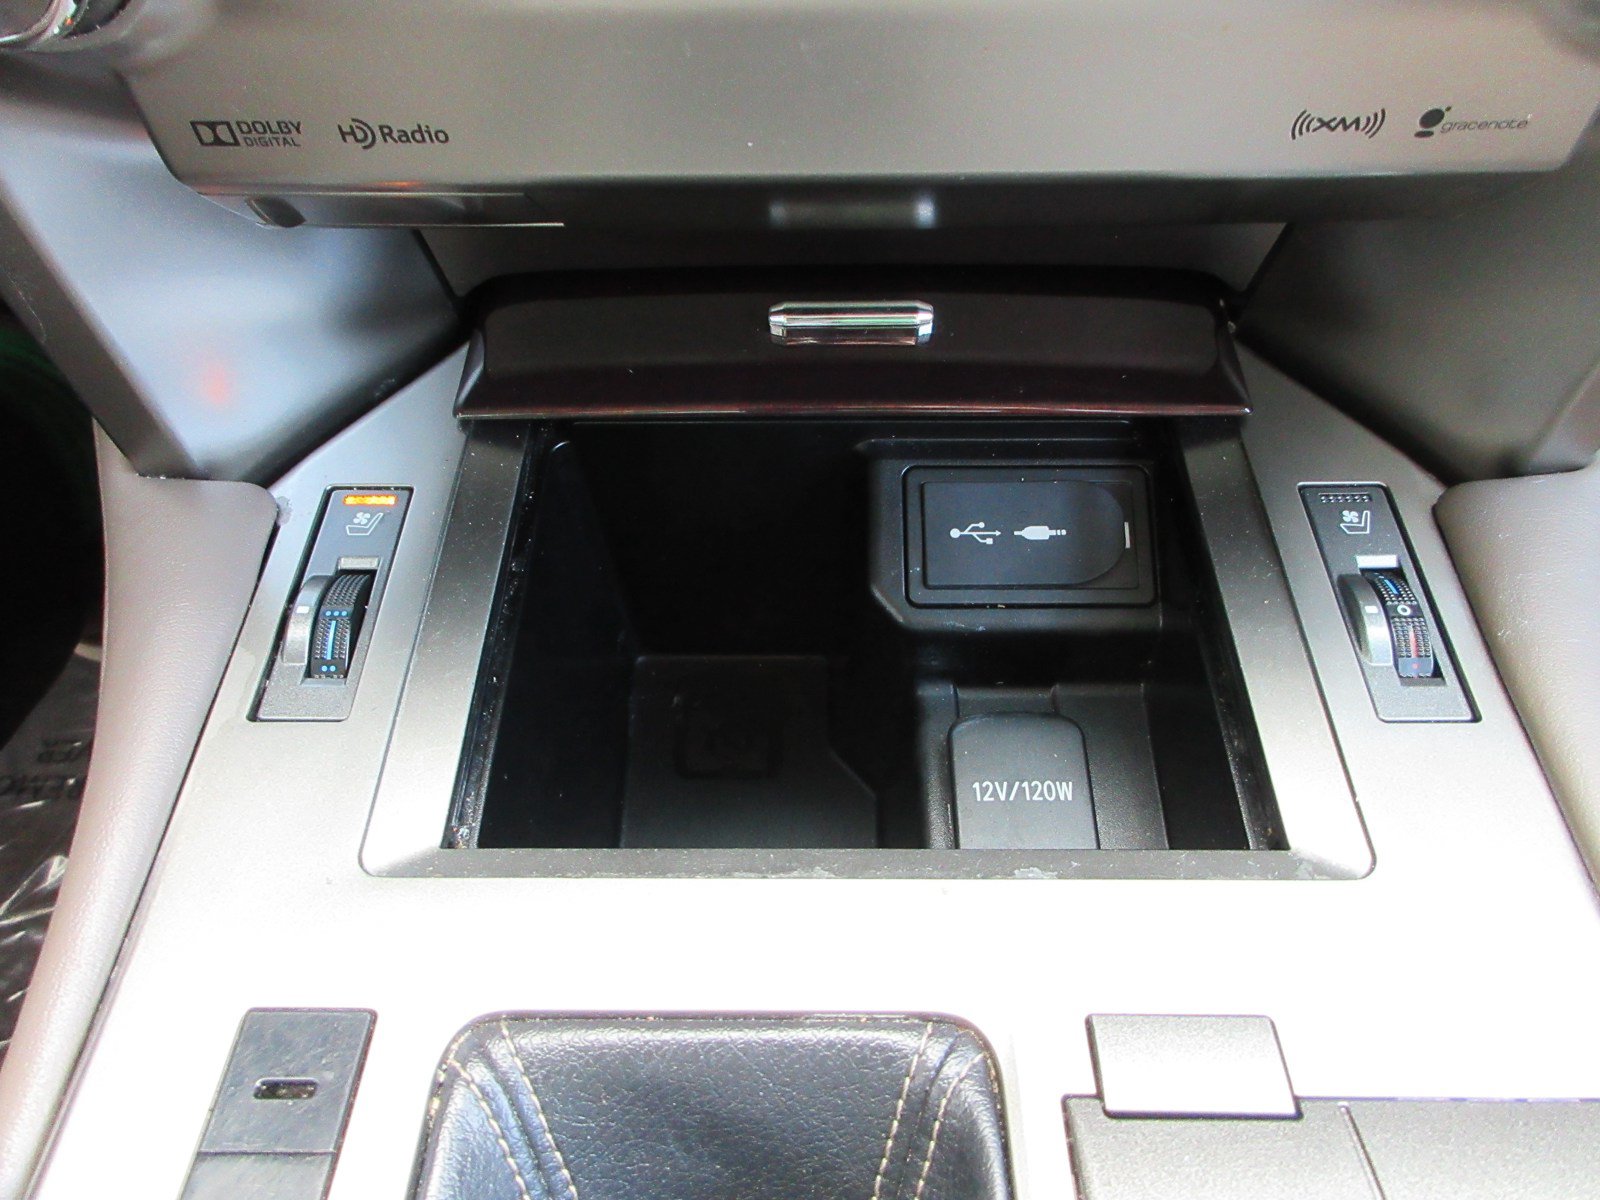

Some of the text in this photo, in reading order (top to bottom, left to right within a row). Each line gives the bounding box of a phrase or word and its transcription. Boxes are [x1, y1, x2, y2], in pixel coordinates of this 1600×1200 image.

[236, 121, 301, 134] DOLBY
[378, 122, 449, 143] Radio
[1438, 119, 1528, 134] gracenote
[243, 136, 301, 147] DIGITAL
[972, 780, 1073, 801] 12V/120W
